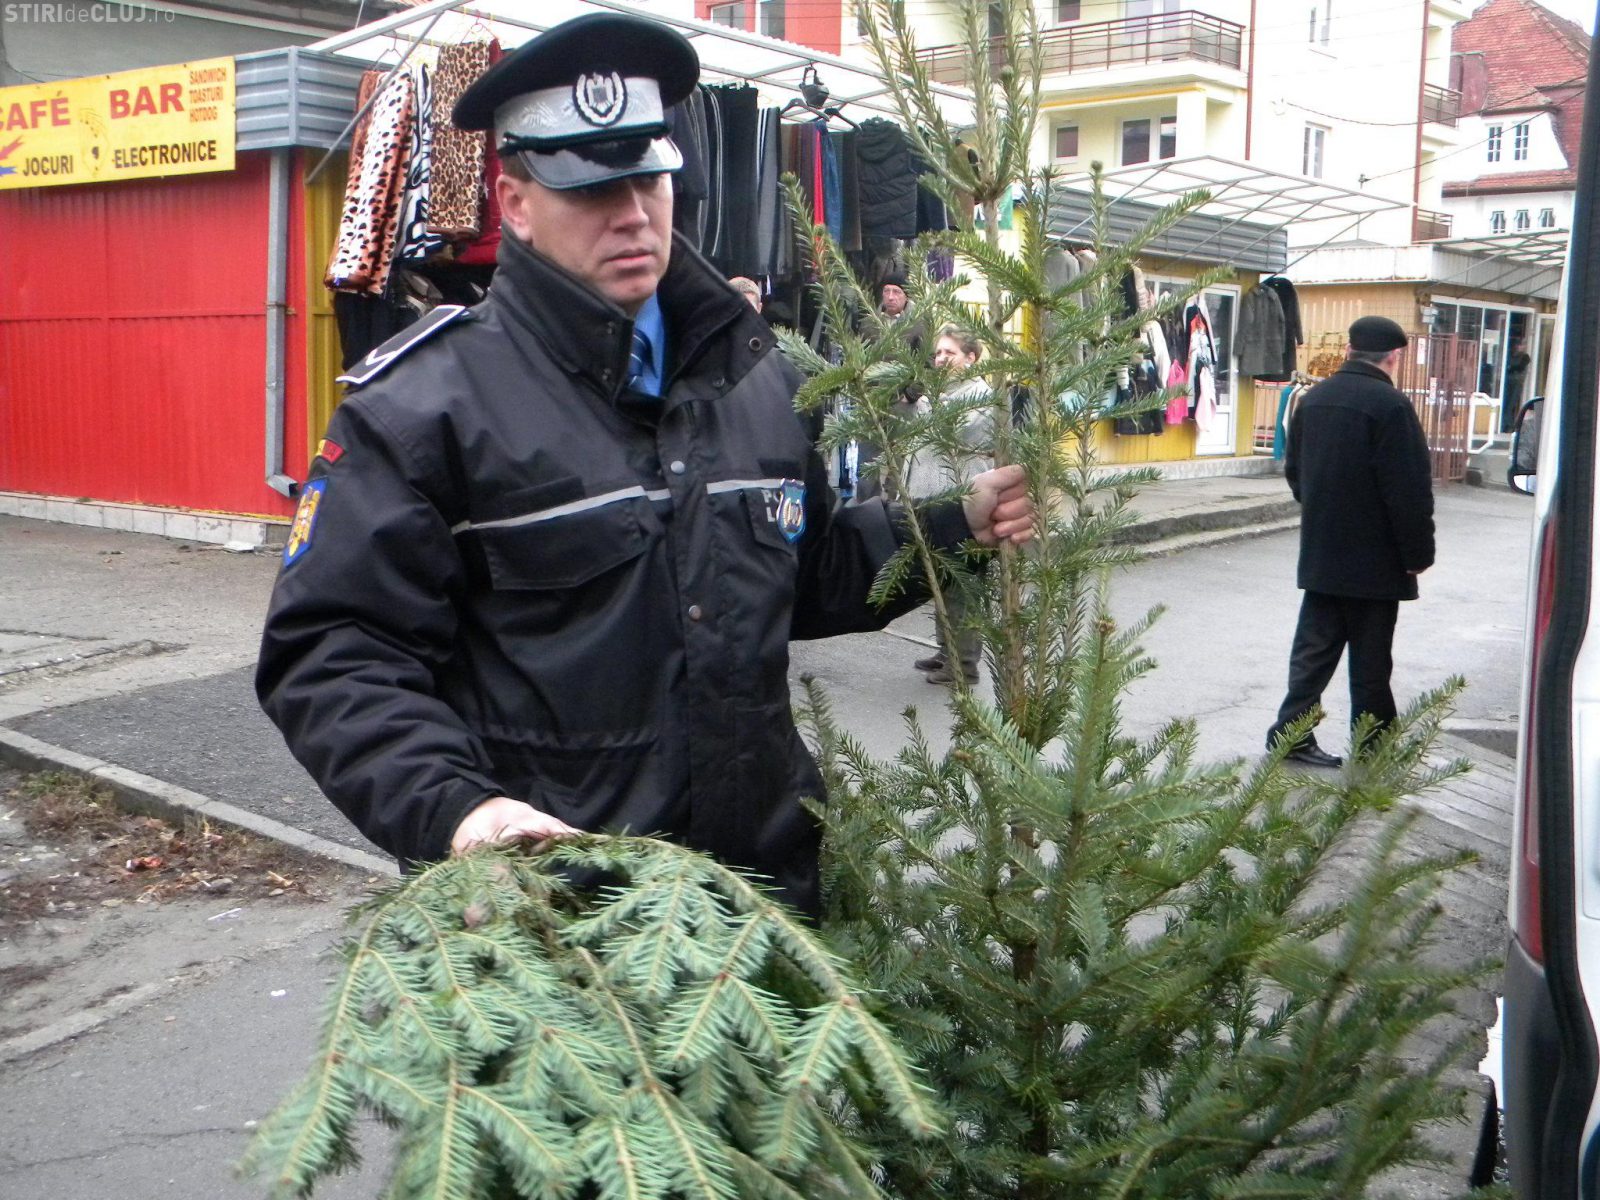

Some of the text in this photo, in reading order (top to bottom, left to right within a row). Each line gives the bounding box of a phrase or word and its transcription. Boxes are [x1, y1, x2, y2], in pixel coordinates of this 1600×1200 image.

[189, 67, 227, 84] SANDWICH
[0, 82, 184, 131] AFÉ BAR
[189, 106, 218, 122] HOTDOG
[22, 140, 217, 176] JOCURI ELECTRONICE
